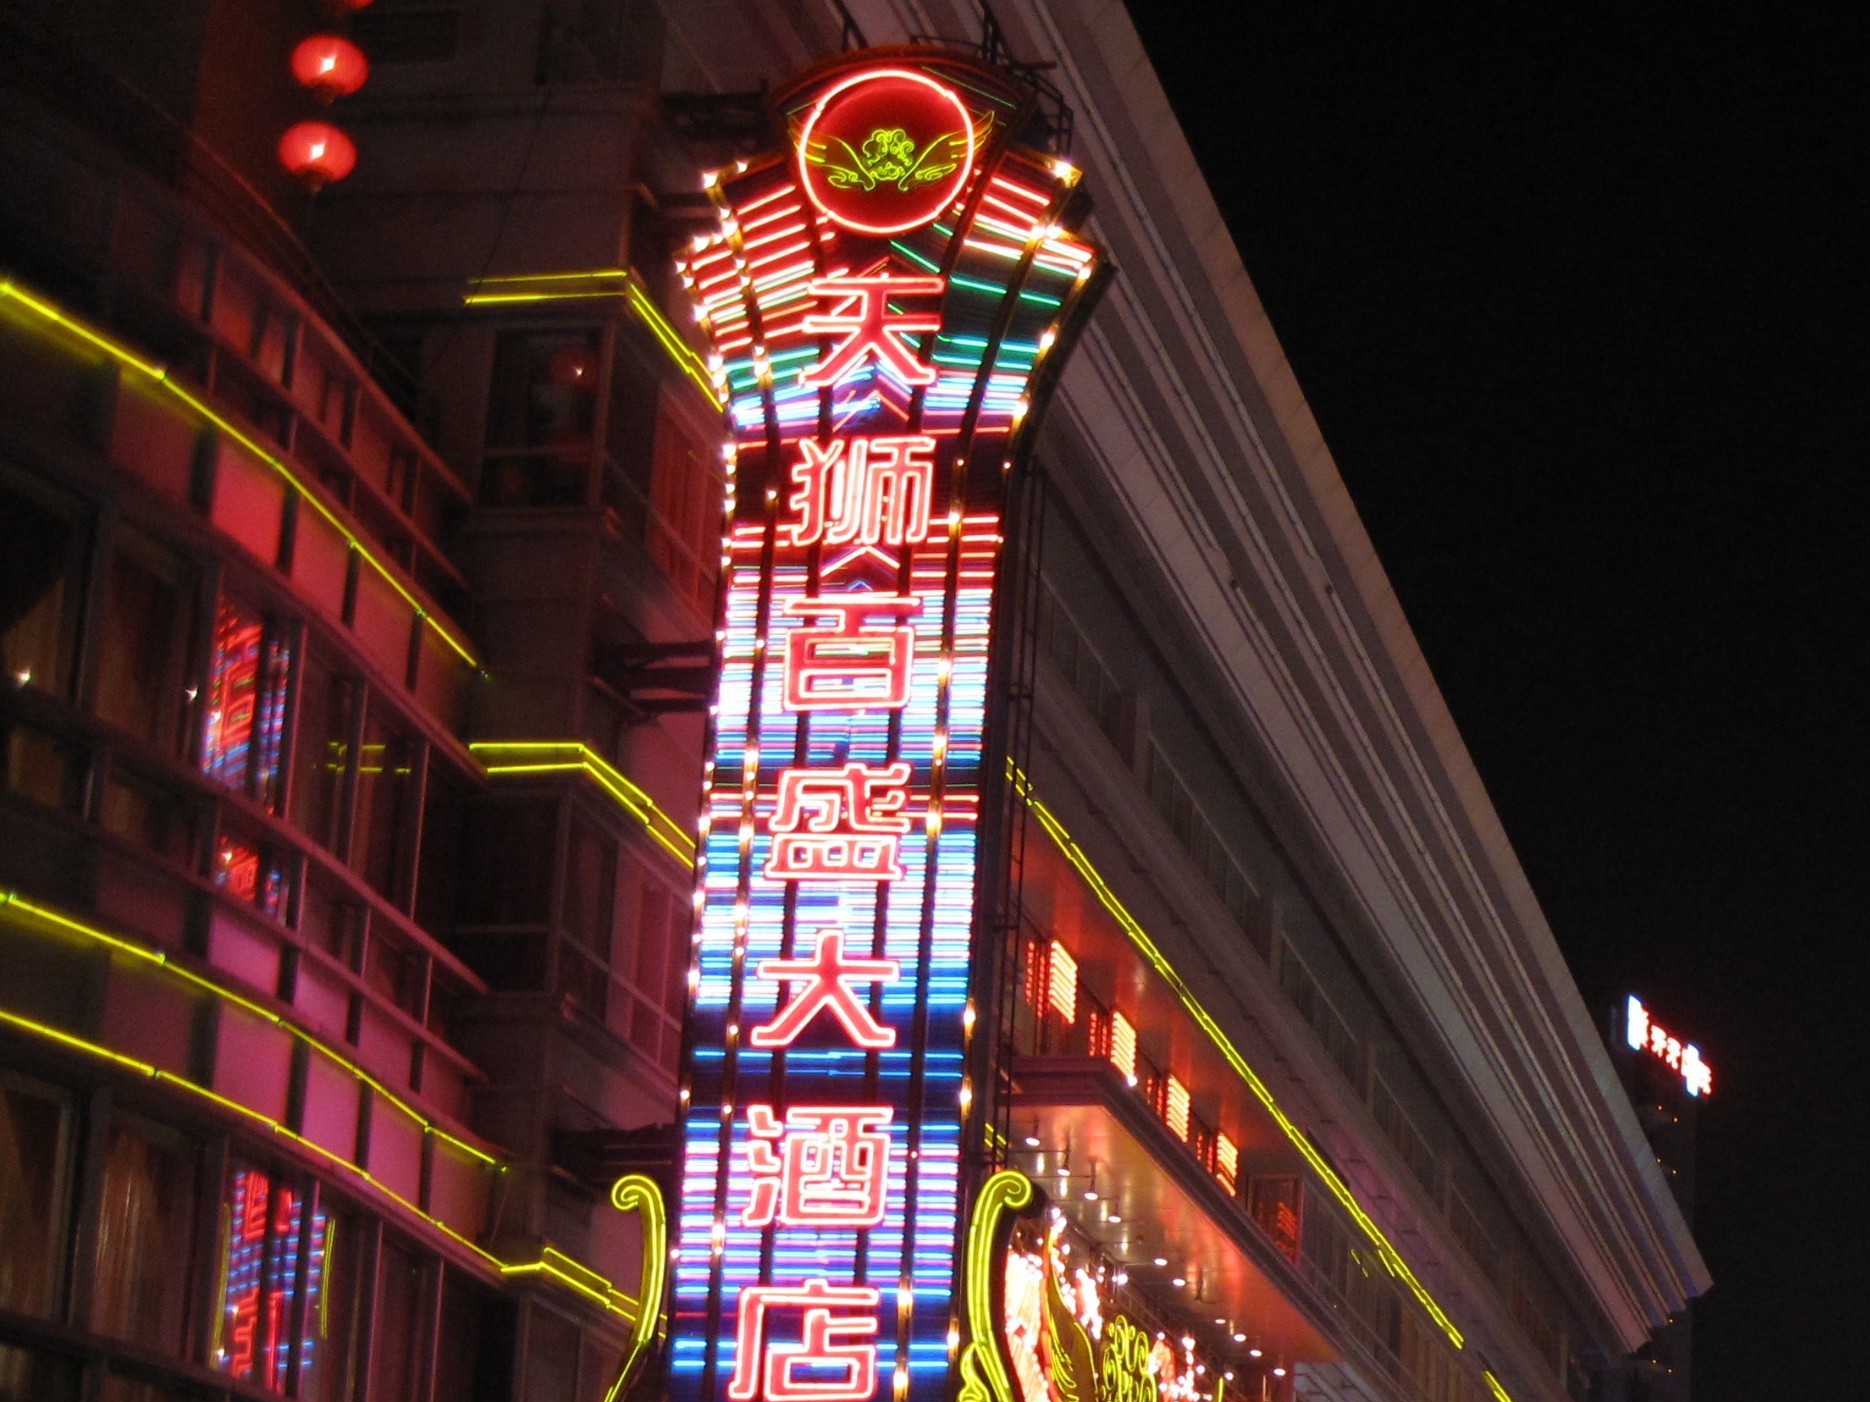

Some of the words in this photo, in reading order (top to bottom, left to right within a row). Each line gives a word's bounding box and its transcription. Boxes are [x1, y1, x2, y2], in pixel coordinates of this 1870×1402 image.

[729, 274, 945, 1402] 天狮百盛大酒店
